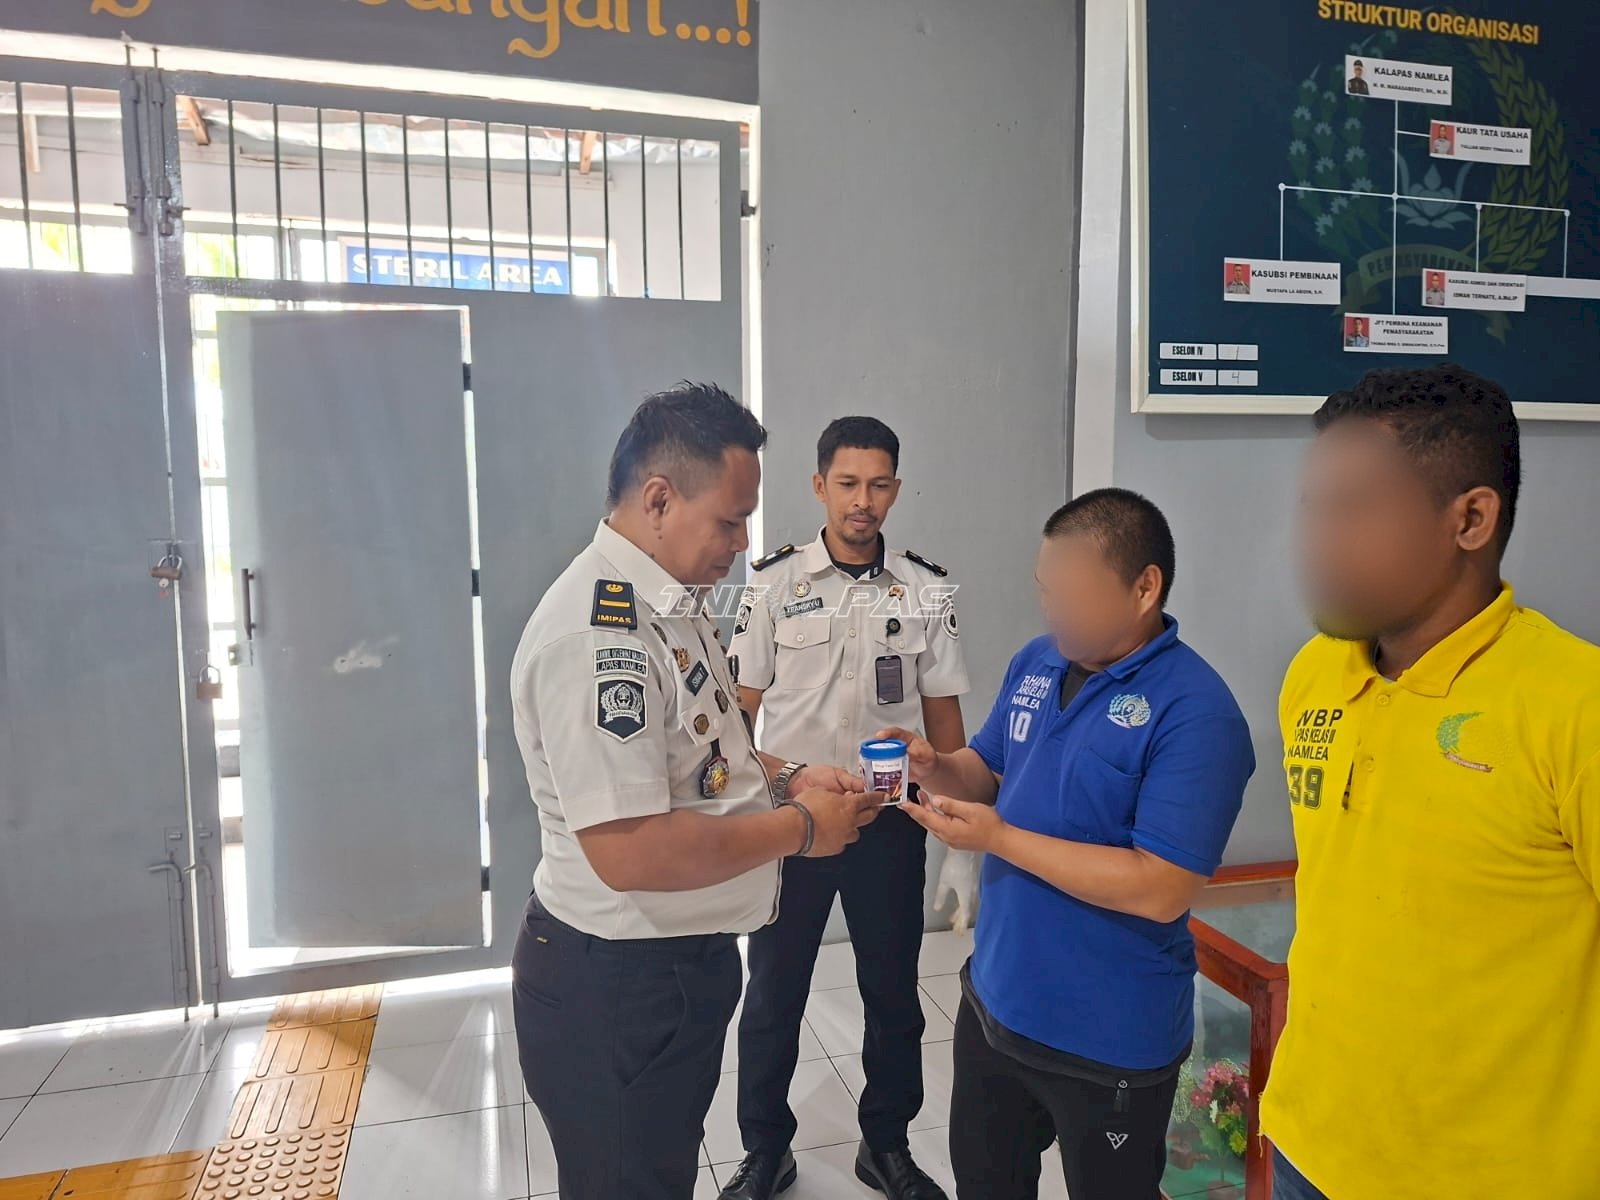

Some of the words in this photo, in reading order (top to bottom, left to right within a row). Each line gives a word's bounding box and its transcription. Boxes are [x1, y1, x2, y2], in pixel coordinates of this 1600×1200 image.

[1318, 0, 1422, 31] STRUKTUR
[1427, 11, 1539, 46] ORGANISASI
[1374, 66, 1413, 79] KALAPAS
[1414, 71, 1450, 82] NAMLEA
[1456, 126, 1478, 136] KAUR
[1480, 128, 1499, 137] TATA
[1500, 130, 1529, 139] USAHA
[352, 253, 469, 280] STERIL
[476, 262, 564, 287] AREA
[1252, 269, 1288, 279] KASUBSI
[1289, 271, 1339, 281] PEMBINAAN
[1172, 345, 1196, 355] ESELON
[1197, 346, 1204, 356] IV
[1172, 371, 1197, 382] ESELON
[597, 614, 632, 624] IMIPAS
[620, 660, 646, 674] NAMLEA
[1287, 744, 1328, 761] NAMLEA
[1288, 765, 1324, 810] 39
